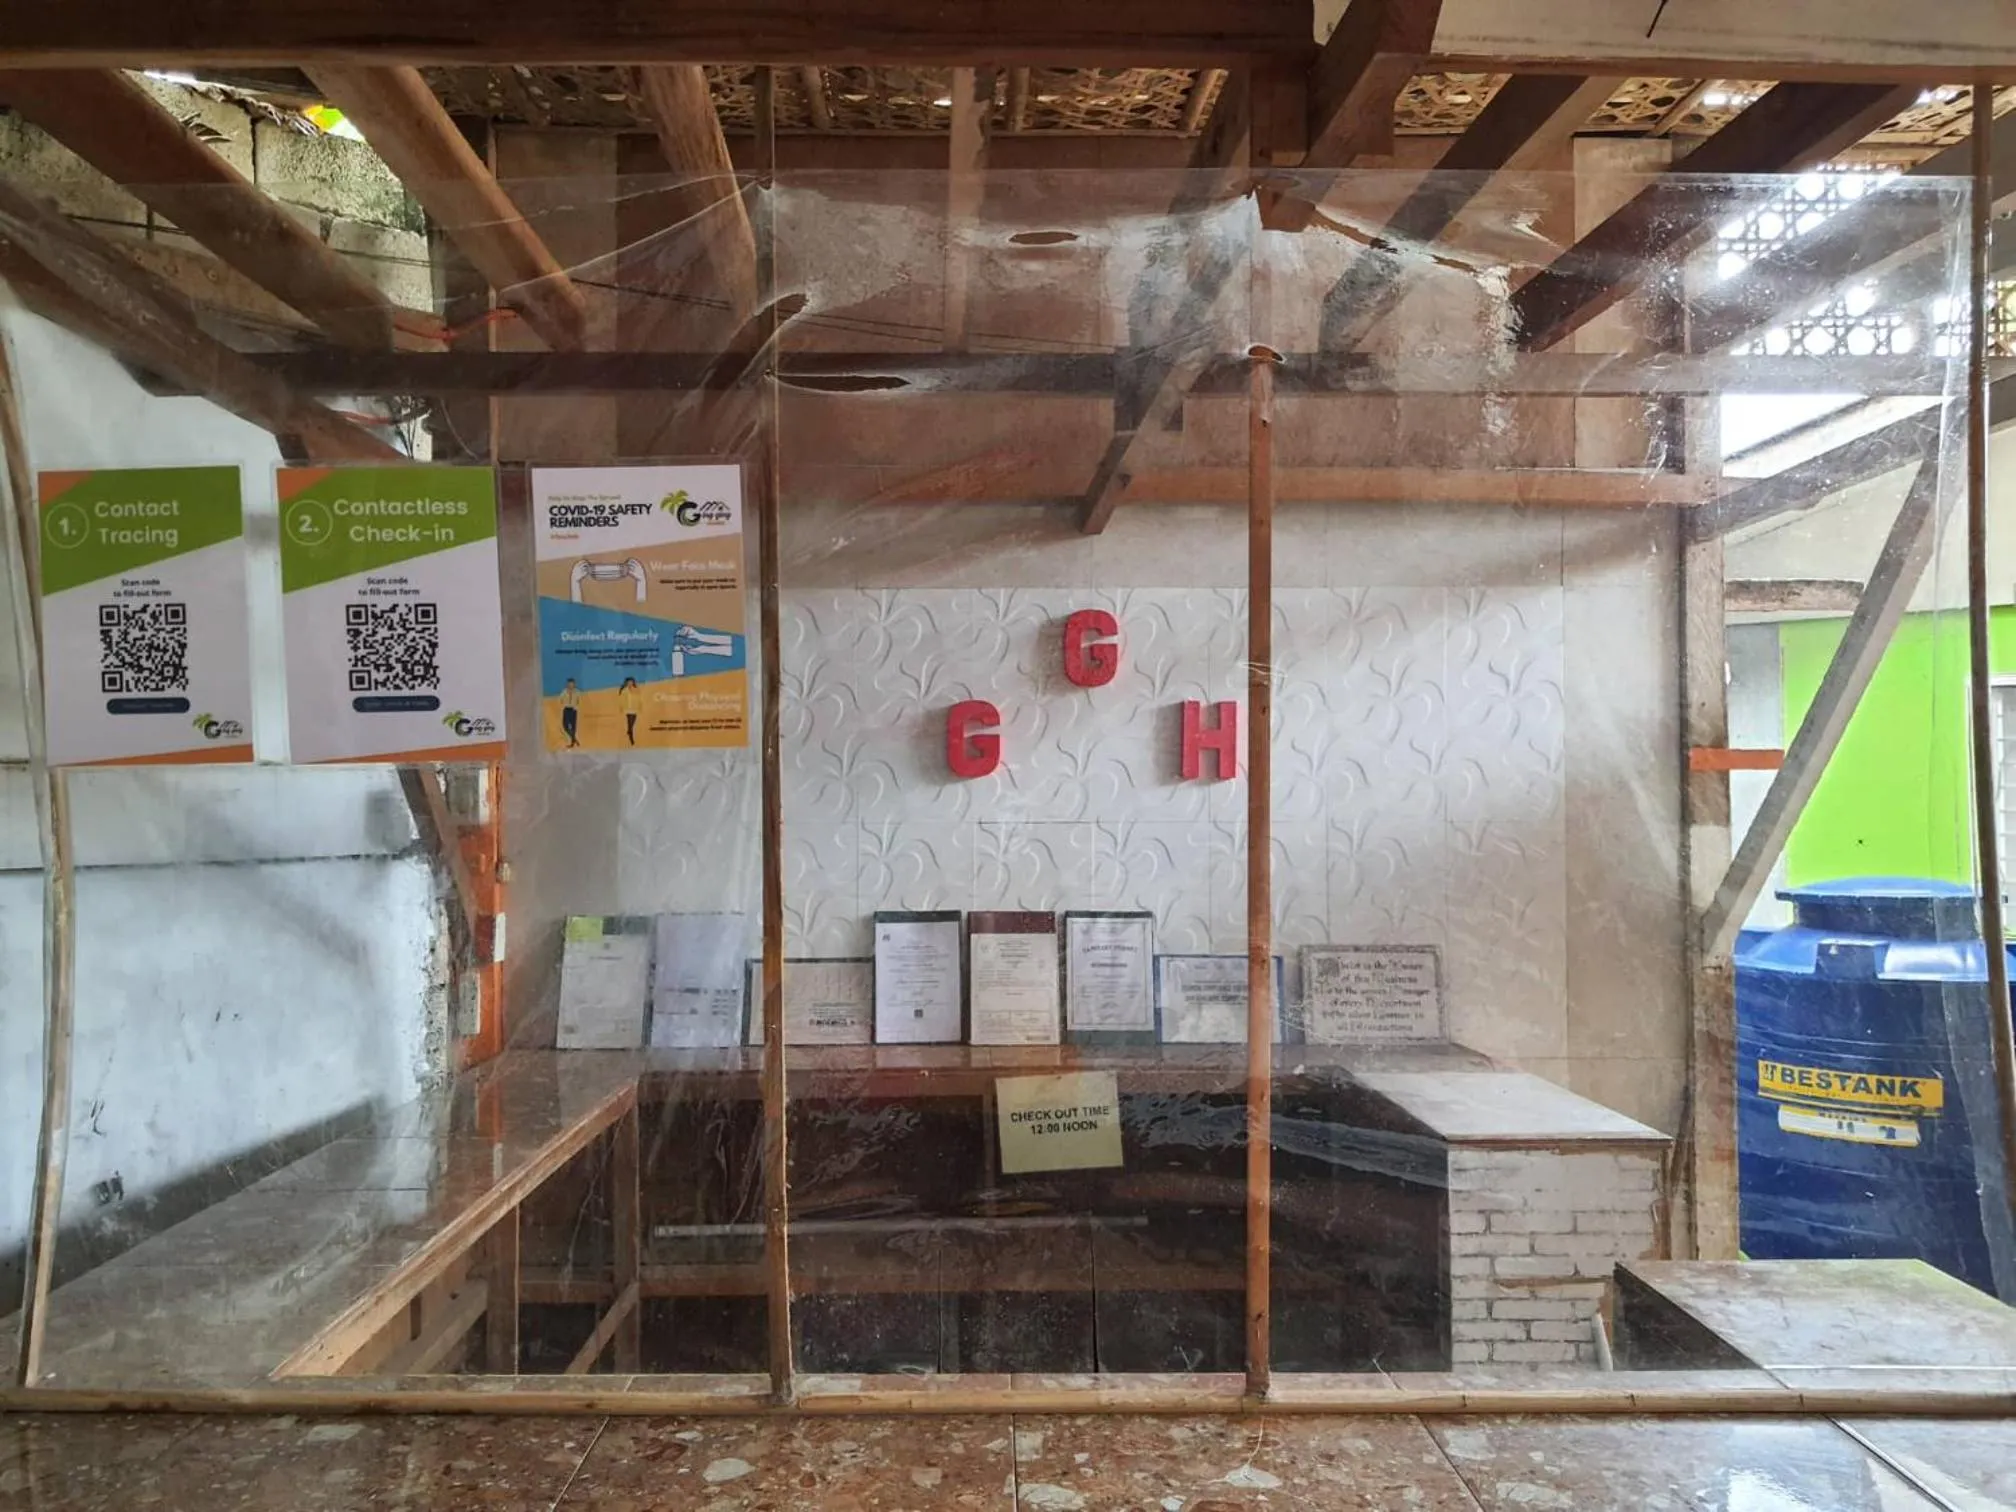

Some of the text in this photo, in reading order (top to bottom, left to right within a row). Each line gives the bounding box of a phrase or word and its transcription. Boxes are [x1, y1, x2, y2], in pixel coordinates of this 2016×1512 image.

[94, 499, 180, 519] Contact
[333, 498, 469, 516] Contactless
[549, 503, 653, 516] COVID-19 SAFETY
[58, 517, 78, 537] 1.
[298, 515, 320, 534] 2.
[549, 515, 620, 528] REMINDERS
[99, 527, 180, 548] Tracing
[348, 523, 456, 544] Check-in
[366, 577, 386, 585] Scan
[1063, 608, 1120, 688] G
[946, 699, 1238, 781] G H
[1780, 1067, 1922, 1098] BESTANK
[1010, 1105, 1110, 1123] CHECK OUT TIME
[1031, 1120, 1098, 1135] 12:00 NOON
